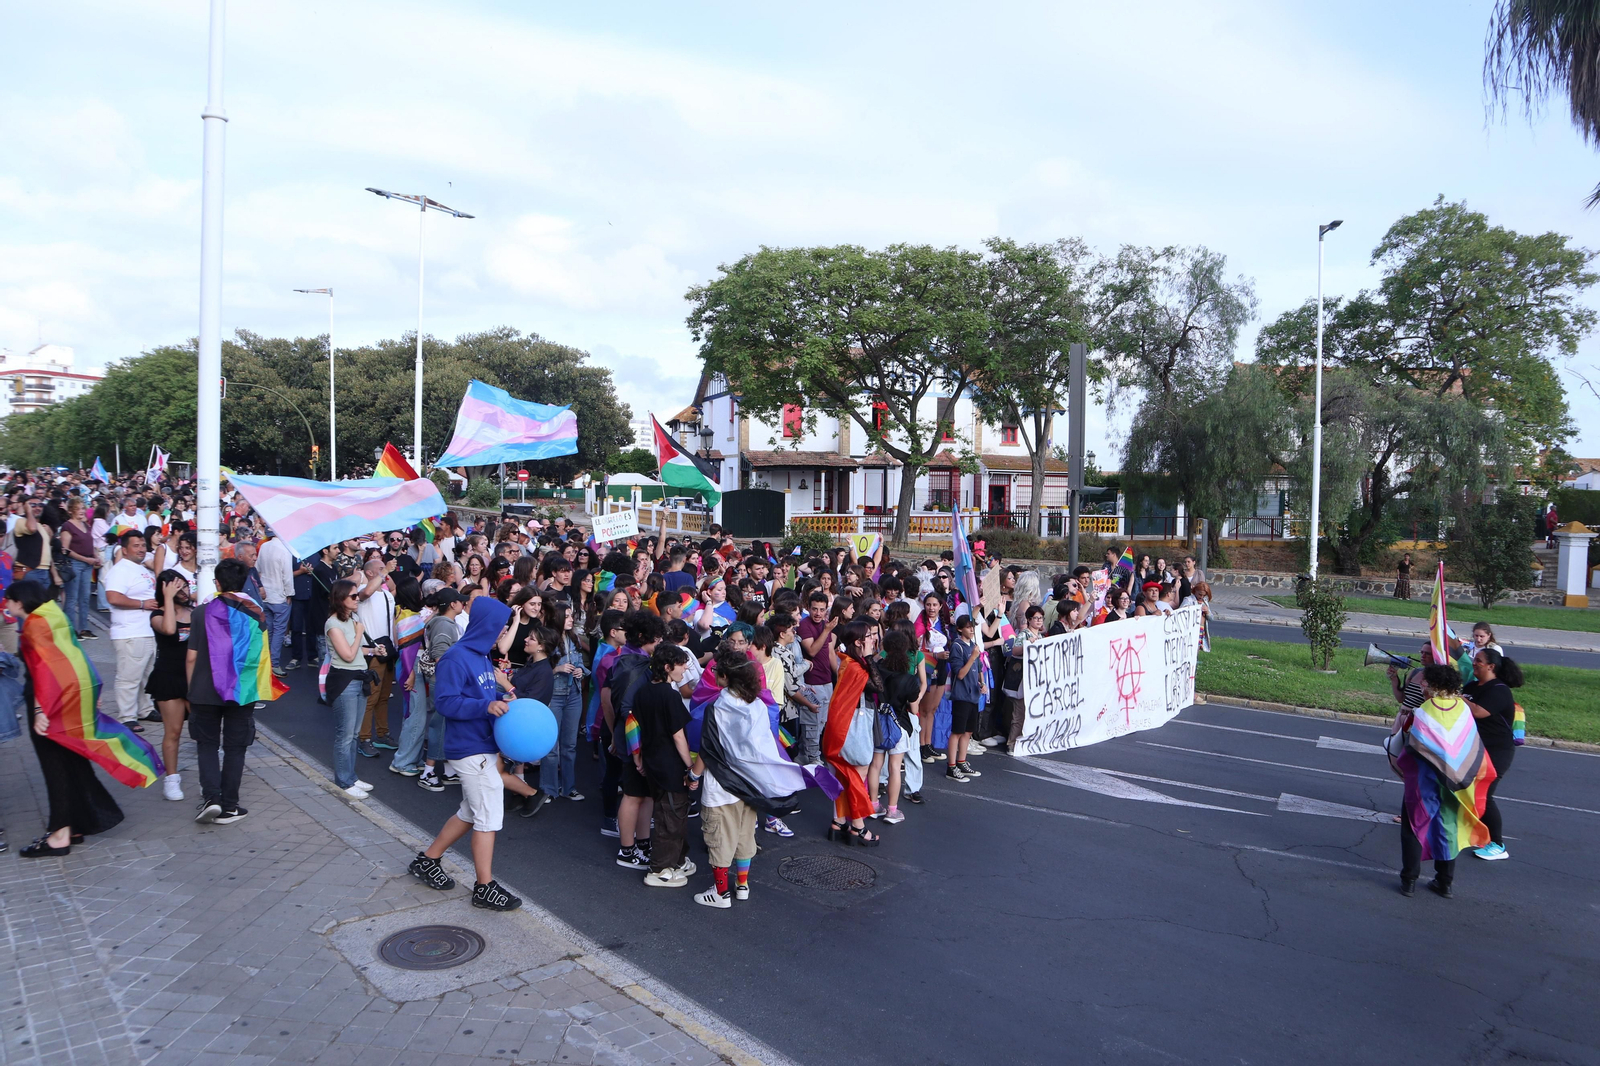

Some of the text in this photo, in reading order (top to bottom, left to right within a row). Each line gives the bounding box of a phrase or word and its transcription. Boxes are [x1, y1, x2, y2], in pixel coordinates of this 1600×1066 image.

[624, 512, 632, 521] ES
[1027, 634, 1084, 690] REFORMA
[415, 859, 448, 886] AIR
[474, 883, 509, 907] AIR
